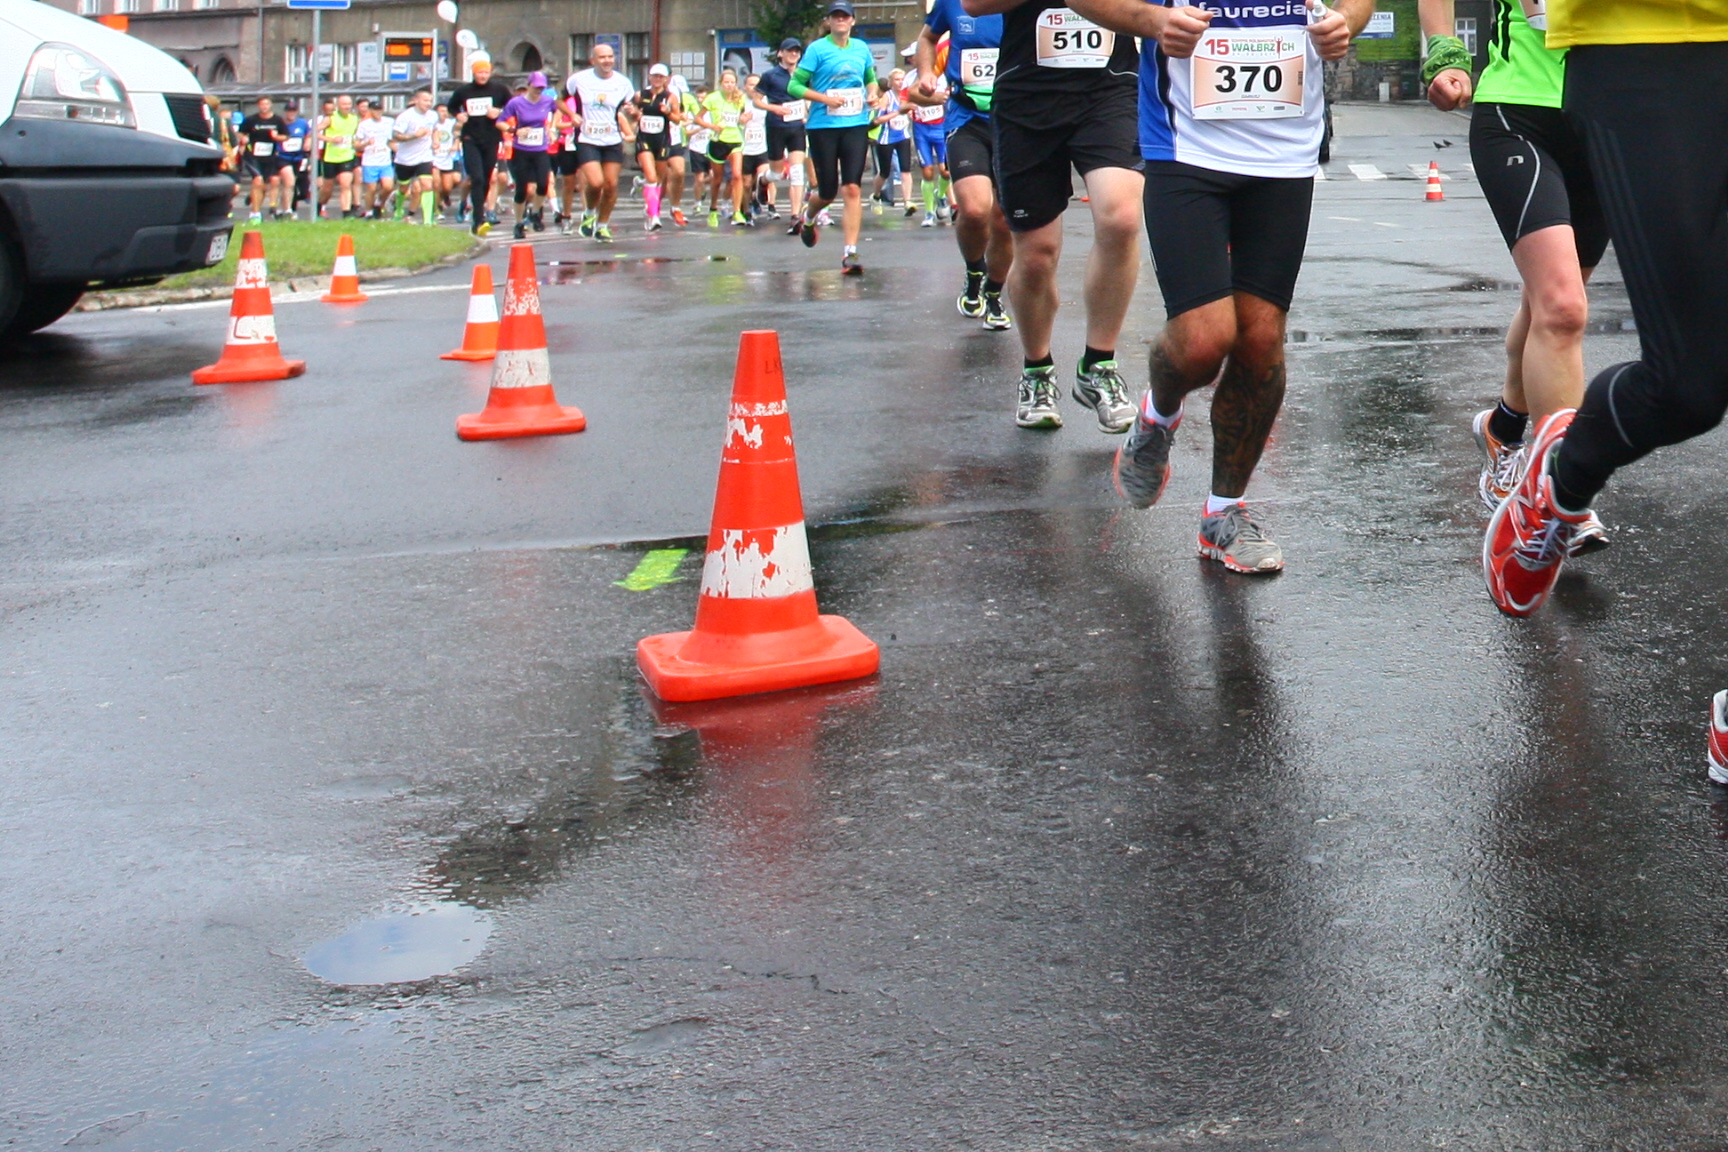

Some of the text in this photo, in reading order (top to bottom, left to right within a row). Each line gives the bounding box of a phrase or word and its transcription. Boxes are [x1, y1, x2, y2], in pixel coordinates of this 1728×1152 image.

[1198, 0, 1307, 19] faurecia
[1046, 13, 1063, 26] 15
[1052, 30, 1103, 50] 510
[1204, 38, 1230, 56] 15
[1215, 65, 1283, 93] 370
